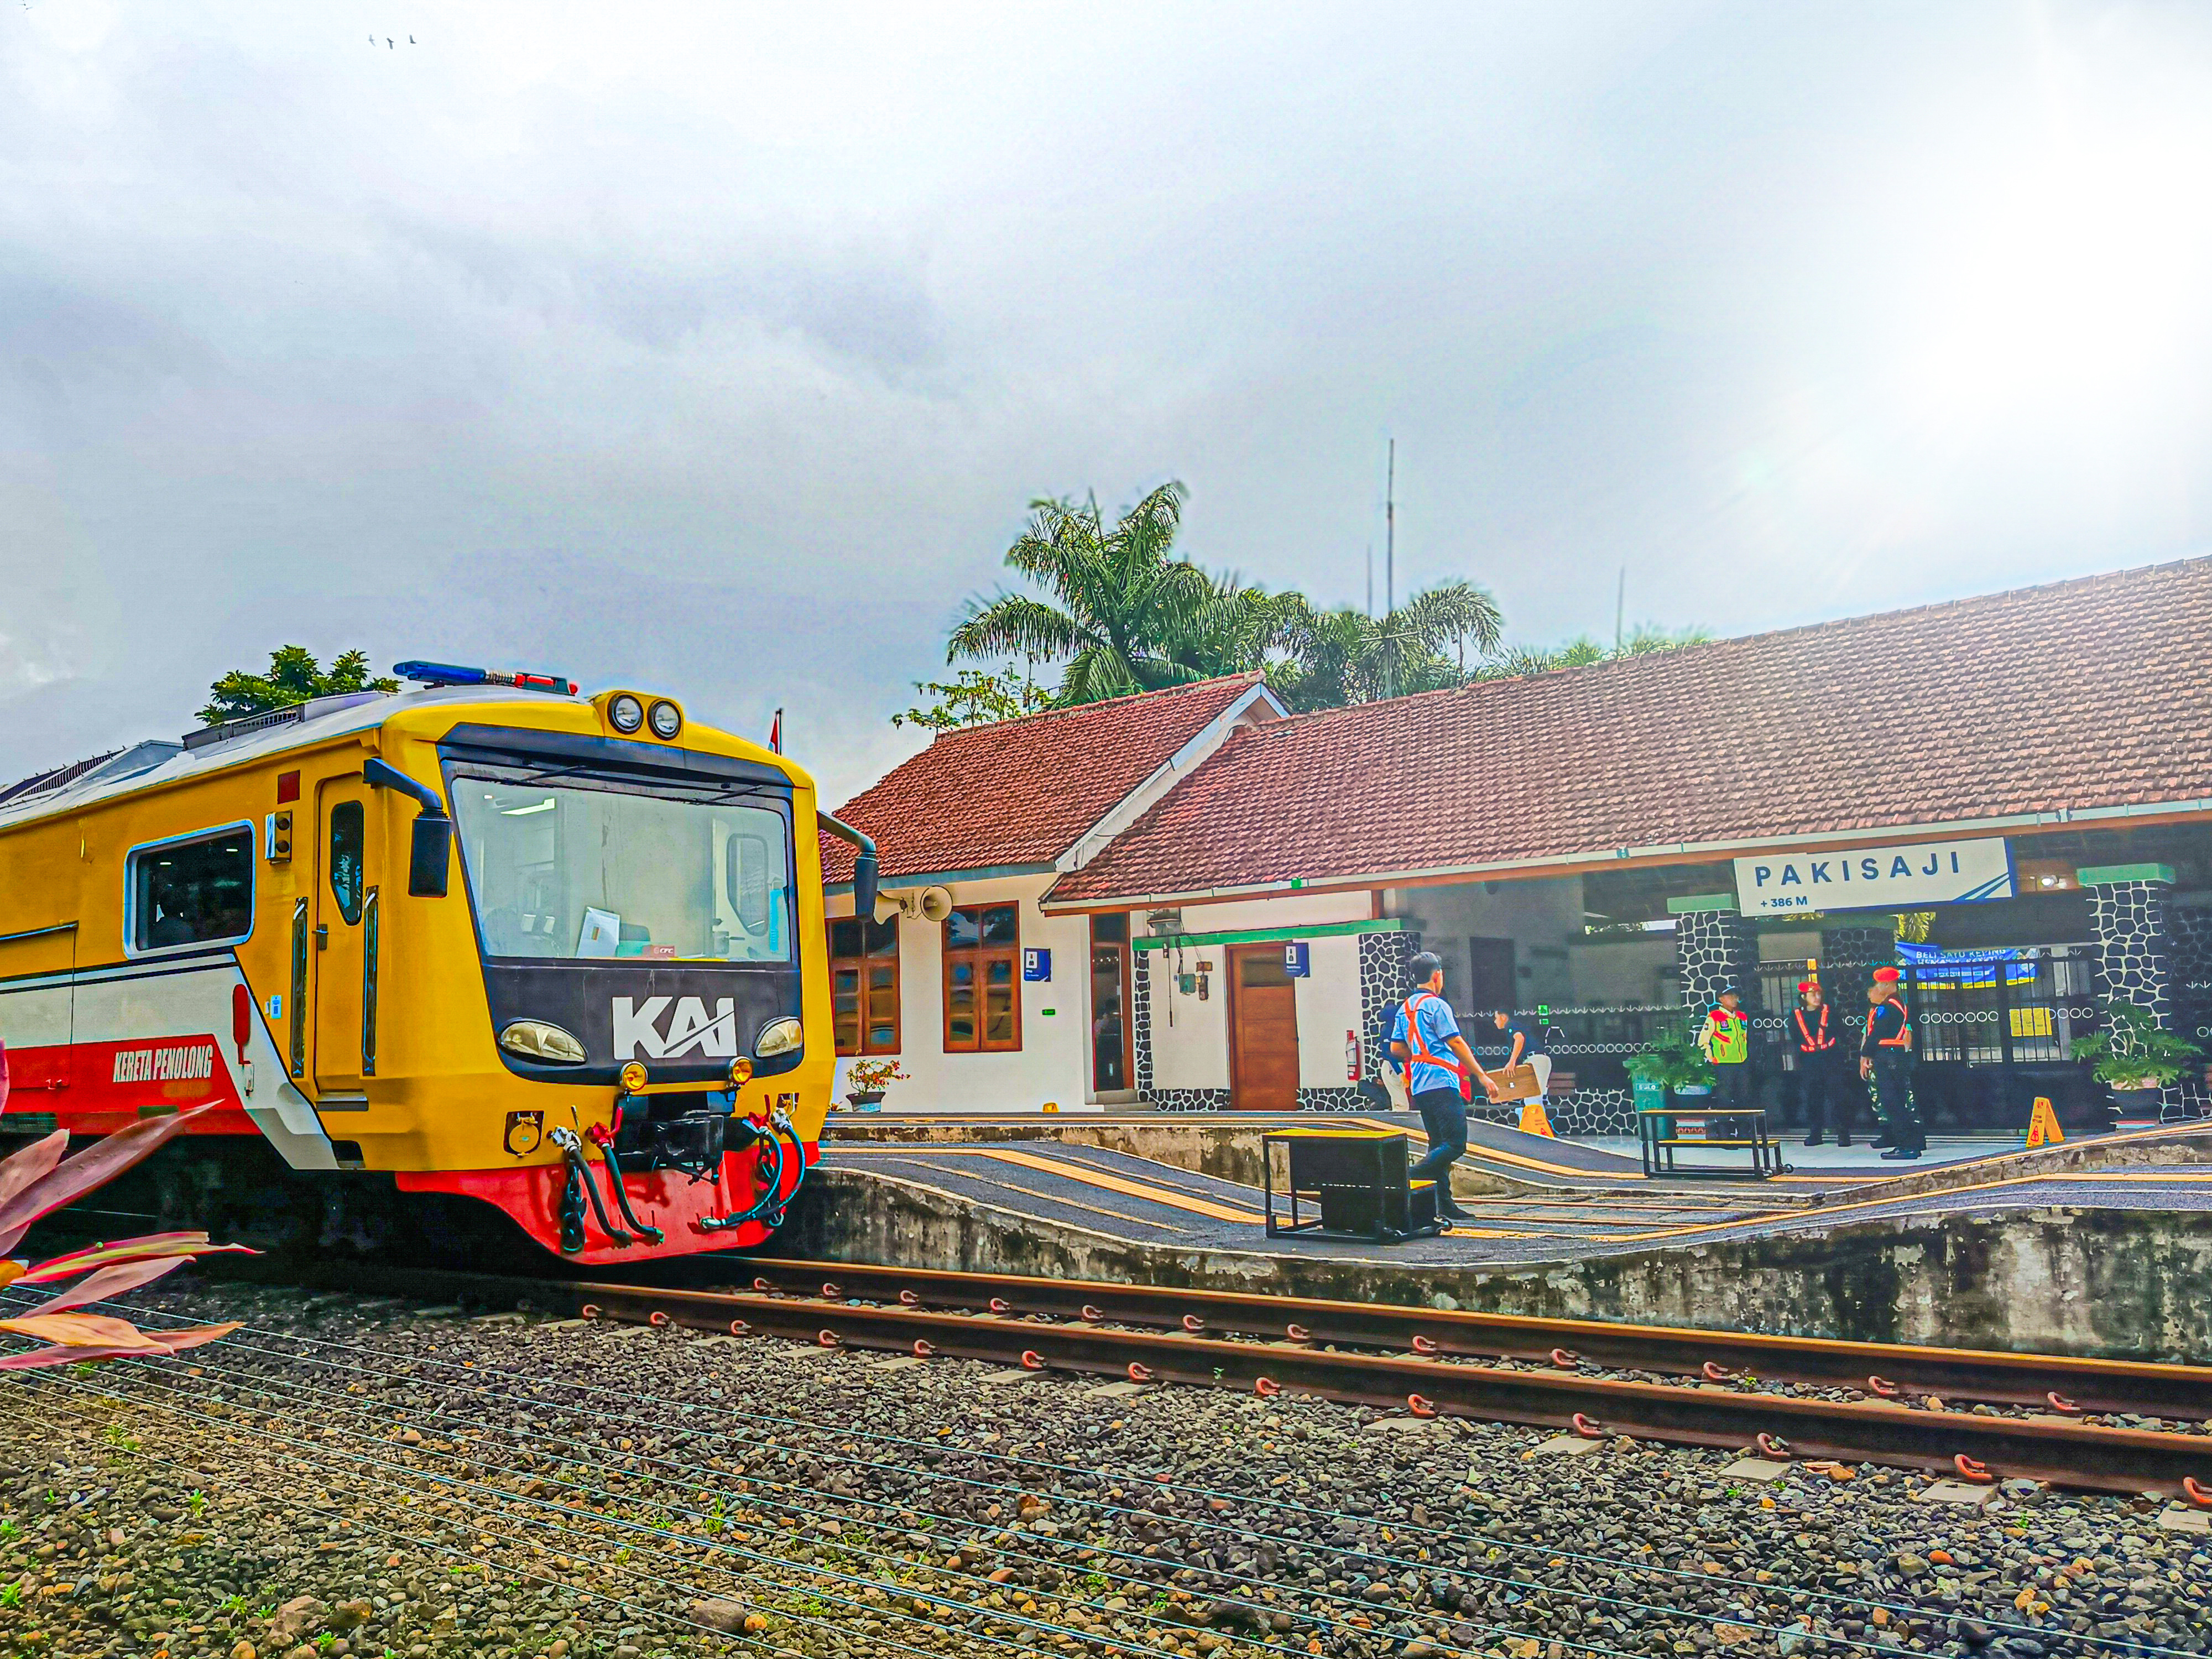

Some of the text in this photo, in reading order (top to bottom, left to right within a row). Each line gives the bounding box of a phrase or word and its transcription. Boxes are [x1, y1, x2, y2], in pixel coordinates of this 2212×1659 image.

[1755, 852, 1959, 886] PAKISAJI
[1771, 897, 1793, 907] 386
[1796, 896, 1808, 906] M
[612, 997, 737, 1060] KAI
[113, 1044, 213, 1082] KERETA PENOLONG
